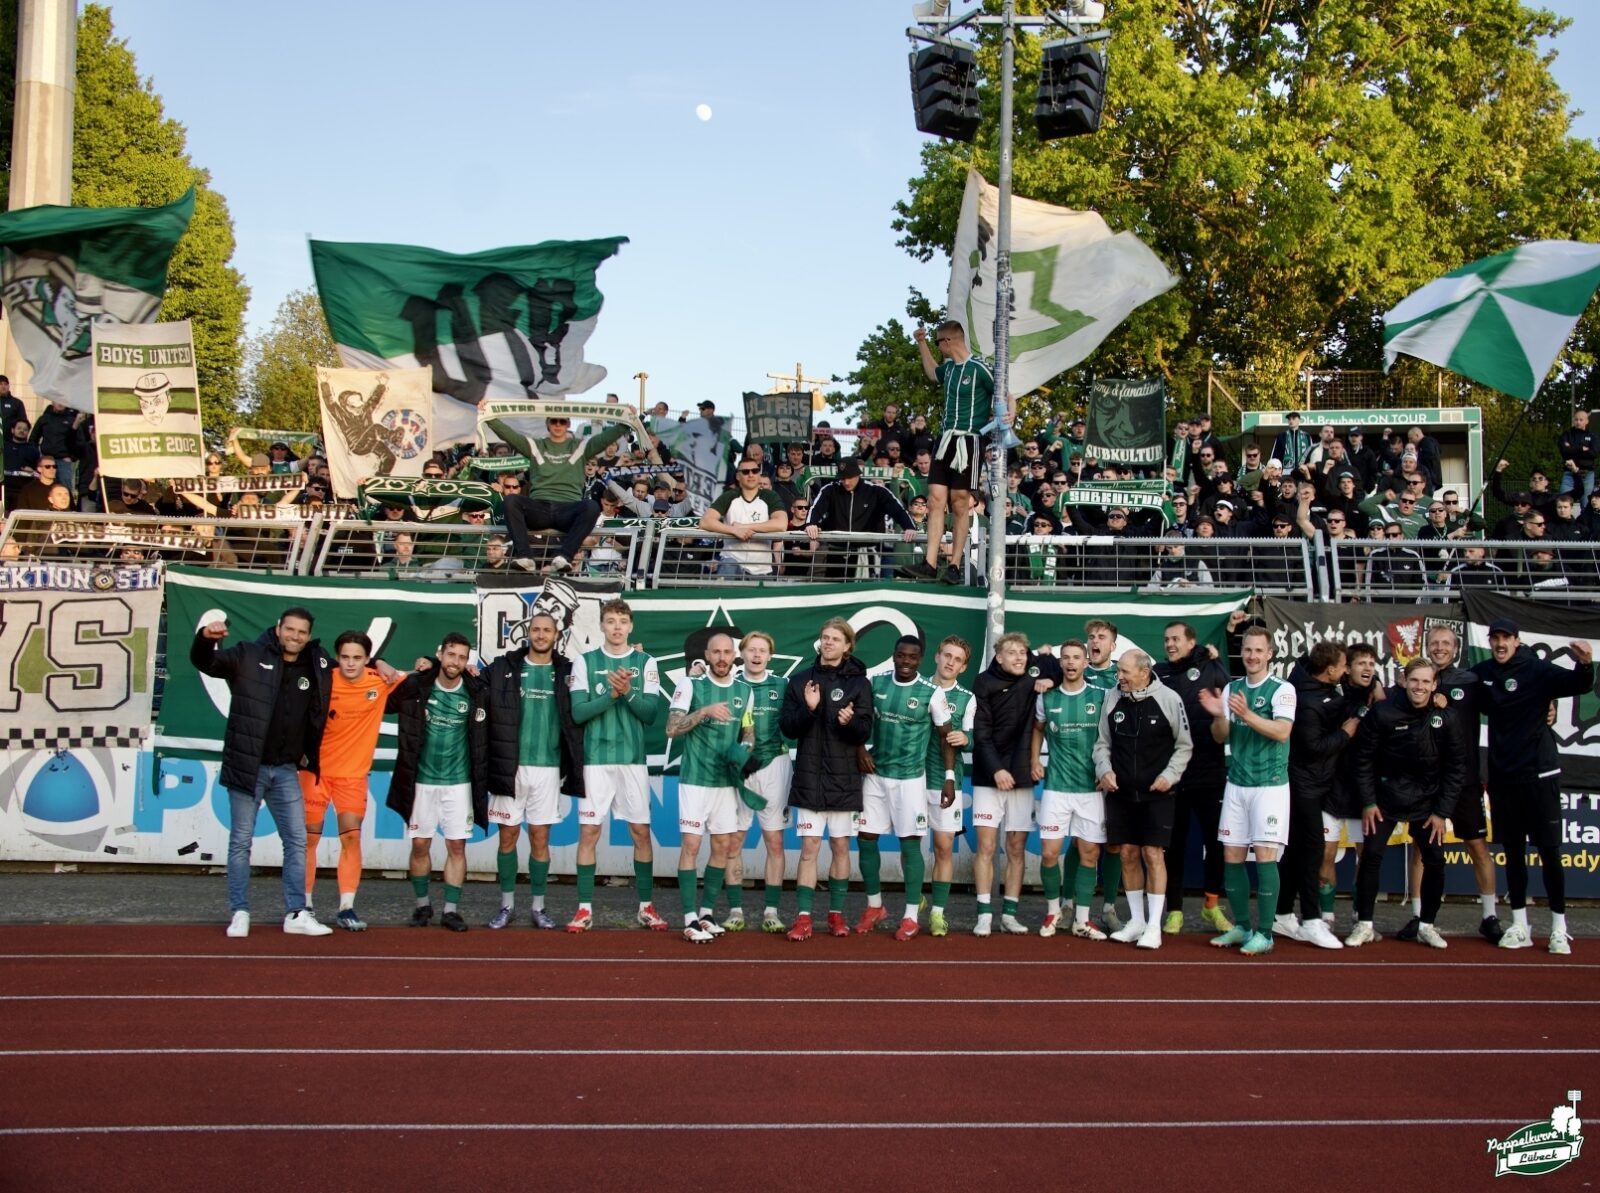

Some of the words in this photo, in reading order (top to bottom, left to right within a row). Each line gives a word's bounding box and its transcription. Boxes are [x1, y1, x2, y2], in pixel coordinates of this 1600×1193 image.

[100, 346, 144, 365] BOYS
[149, 348, 191, 365] UNITED
[746, 395, 810, 418] ULTRAS
[1368, 414, 1388, 424] ON
[1391, 414, 1427, 424] TOUR
[109, 436, 161, 455] SINCE
[165, 436, 198, 453] 2002
[1084, 443, 1163, 462] SUBKULTUR
[174, 476, 218, 493] BOYS
[238, 474, 304, 491] UNITED
[1070, 490, 1163, 507] SUBKULTUR
[239, 504, 276, 520] OYS
